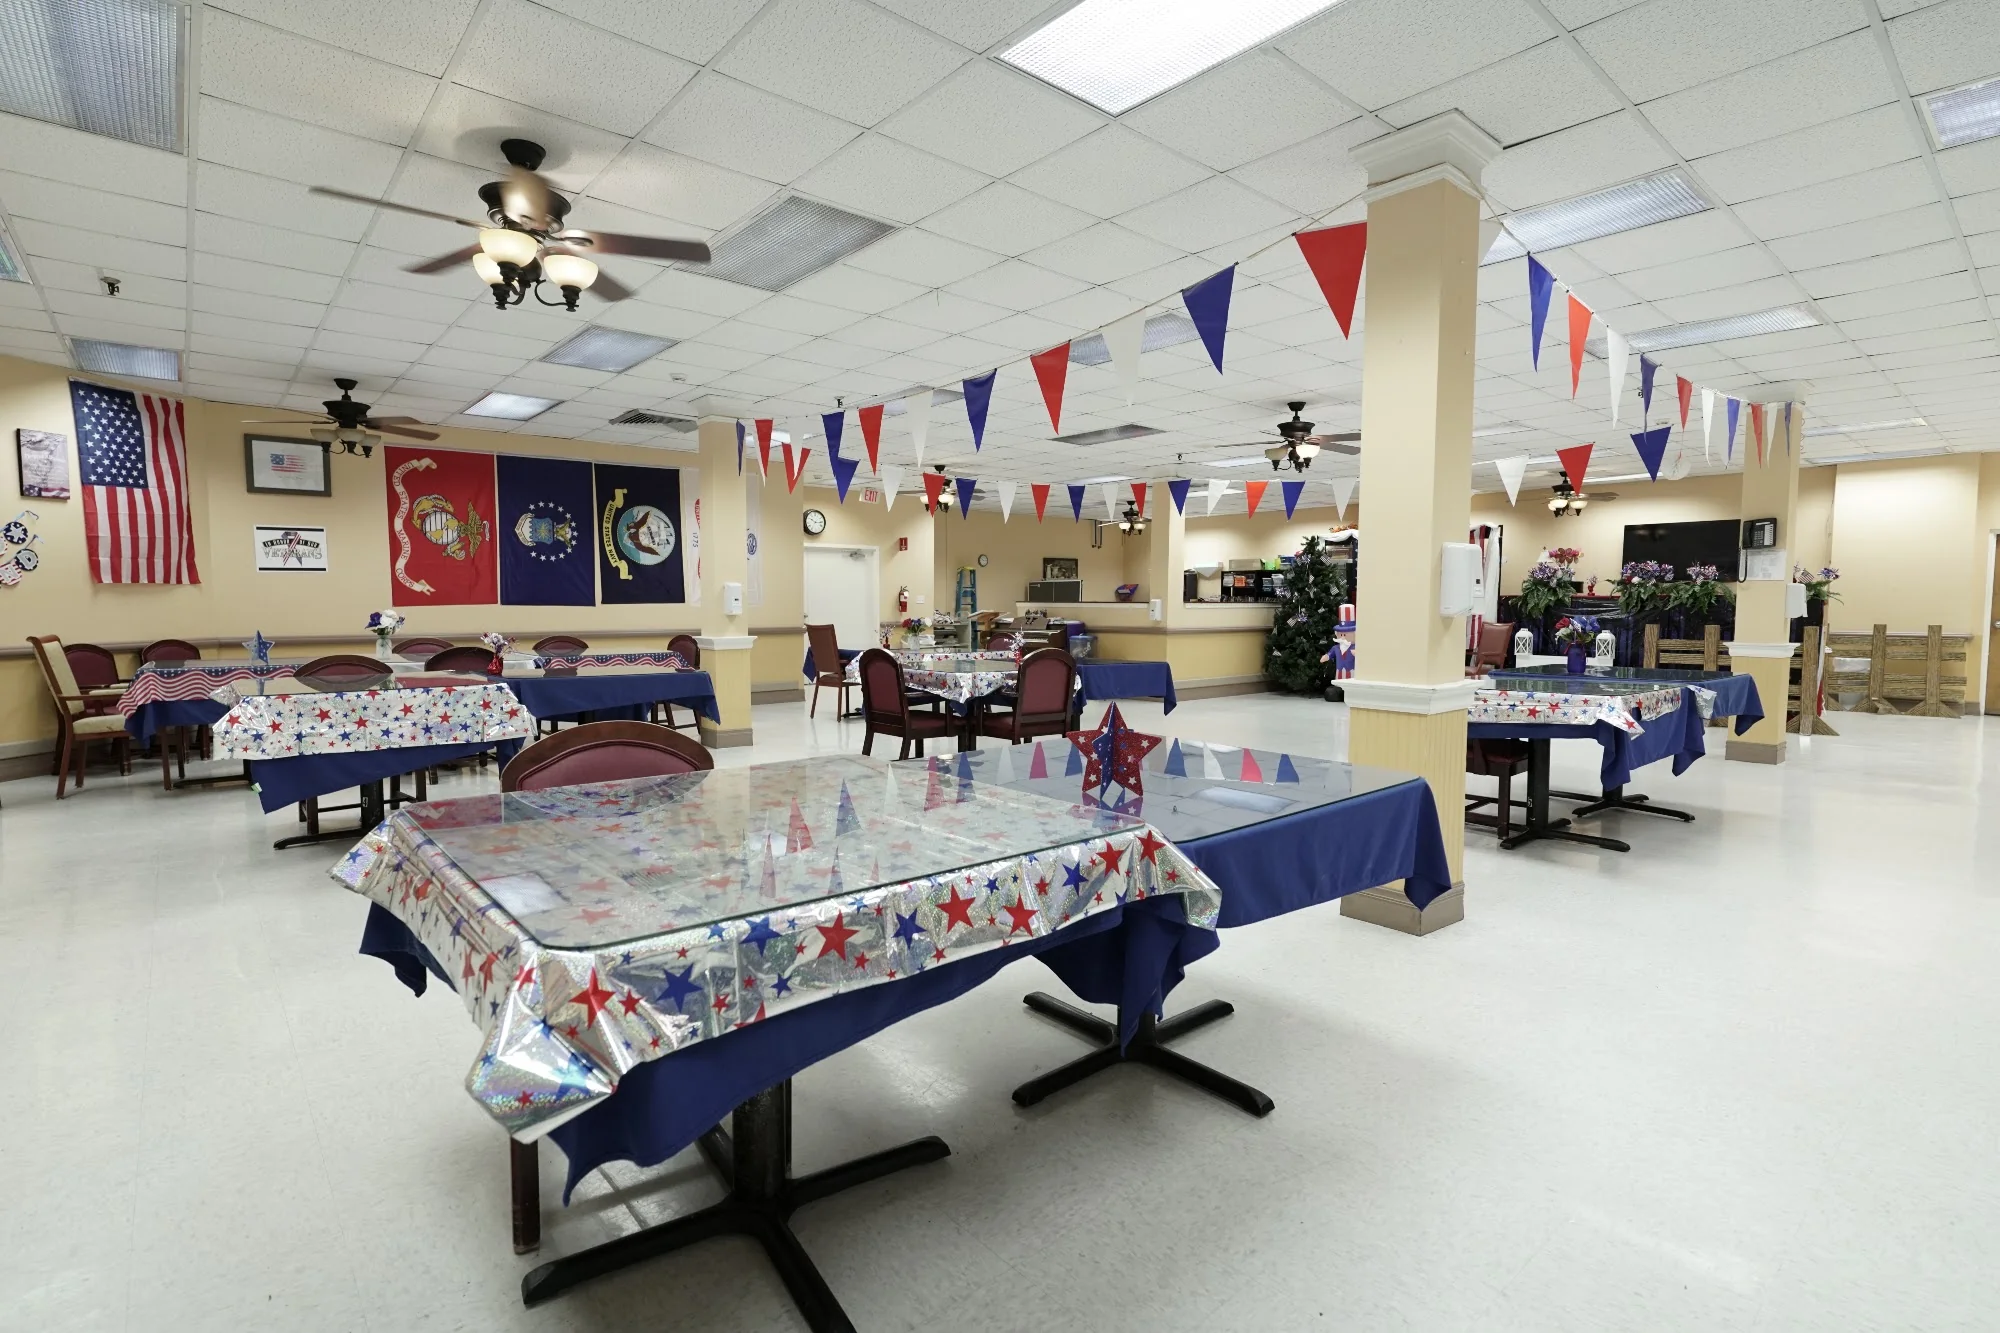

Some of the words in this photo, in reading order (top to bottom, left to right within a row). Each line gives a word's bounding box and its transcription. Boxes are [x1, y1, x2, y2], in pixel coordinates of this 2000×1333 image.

[394, 462, 414, 487] UNITED
[397, 491, 408, 520] STATES
[864, 489, 878, 502] EXIT
[605, 503, 615, 525] UNITED
[397, 529, 410, 560] MARINE
[604, 527, 612, 548] STATES
[608, 548, 618, 564] NAVY
[396, 568, 414, 588] CORPS
